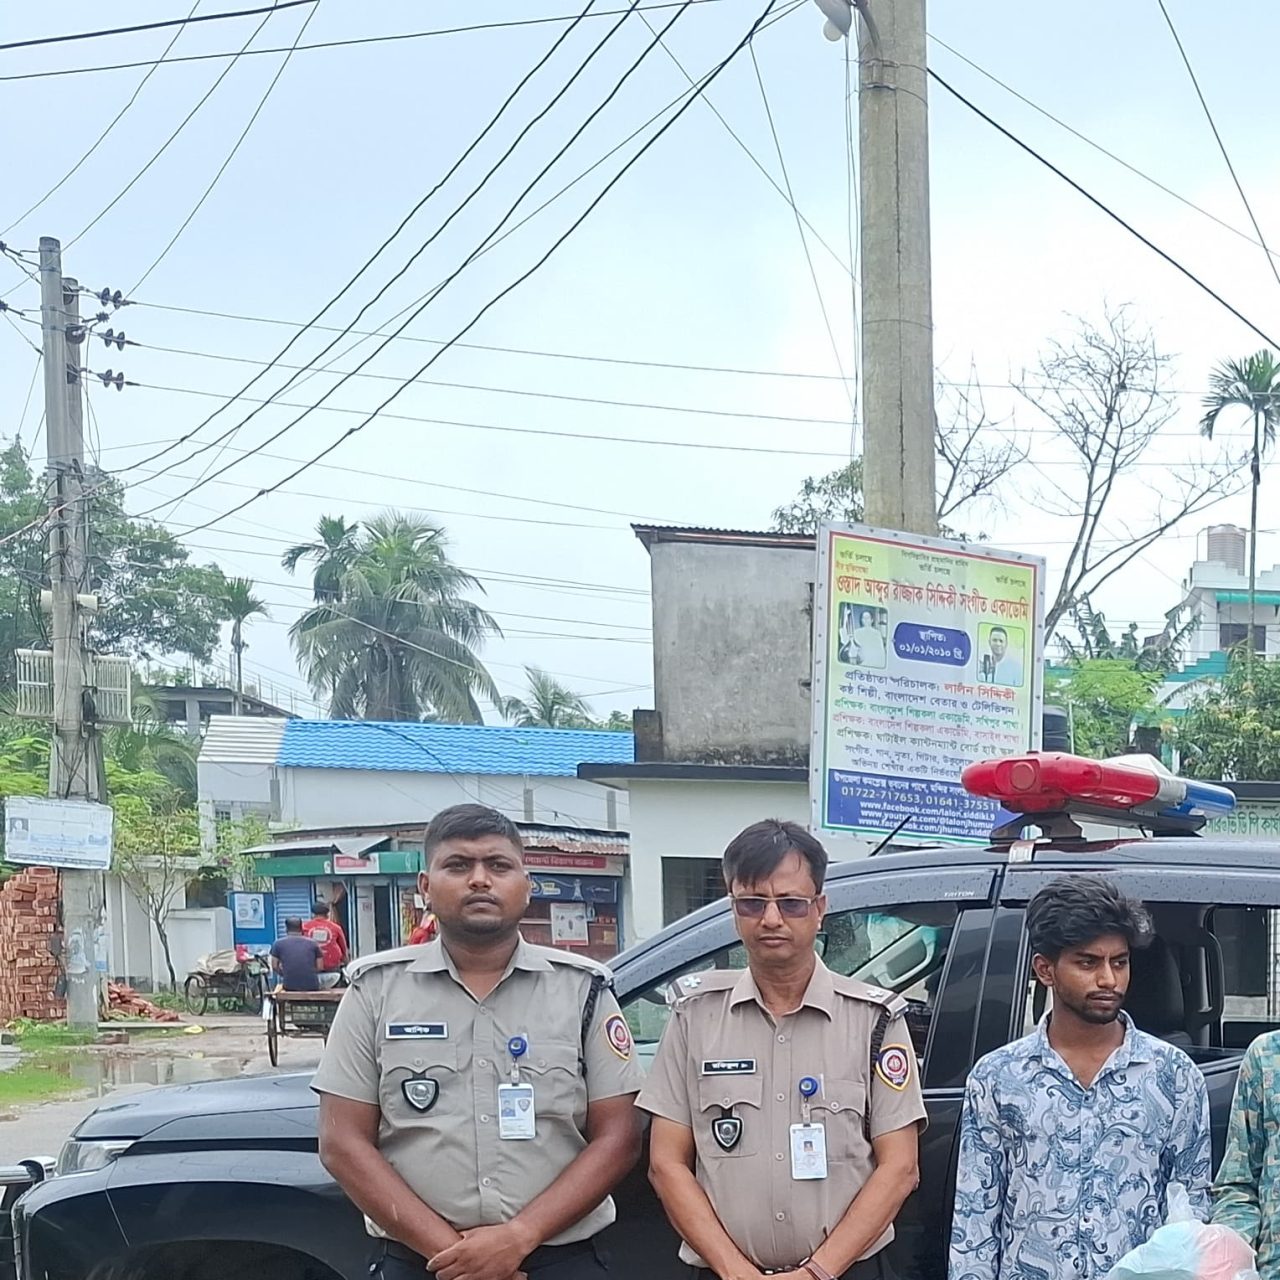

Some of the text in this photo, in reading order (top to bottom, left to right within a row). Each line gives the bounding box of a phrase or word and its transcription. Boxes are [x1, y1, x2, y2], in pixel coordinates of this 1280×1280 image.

[837, 575, 861, 595] ওস্তাদ
[893, 583, 923, 604] রাজ্জাক
[926, 582, 957, 610] সিদ্দিকী
[959, 587, 988, 613] সংগীত
[991, 596, 1029, 620] একাডেমি
[899, 643, 951, 657] ০১/০১/২০১০
[845, 669, 888, 685] প্রতিষ্ঠাতা
[978, 685, 1016, 701] সিদ্দিকী
[870, 704, 903, 715] বাংলাদেশ
[885, 691, 926, 704] বাংলাদেশ
[930, 697, 957, 708] বেতার
[960, 701, 968, 709] ও
[972, 700, 1014, 715] টেলিভিশন
[868, 718, 902, 730] বাংলাদেশ
[841, 786, 924, 805] 01722-717653,
[926, 795, 1001, 812] 01641-375511
